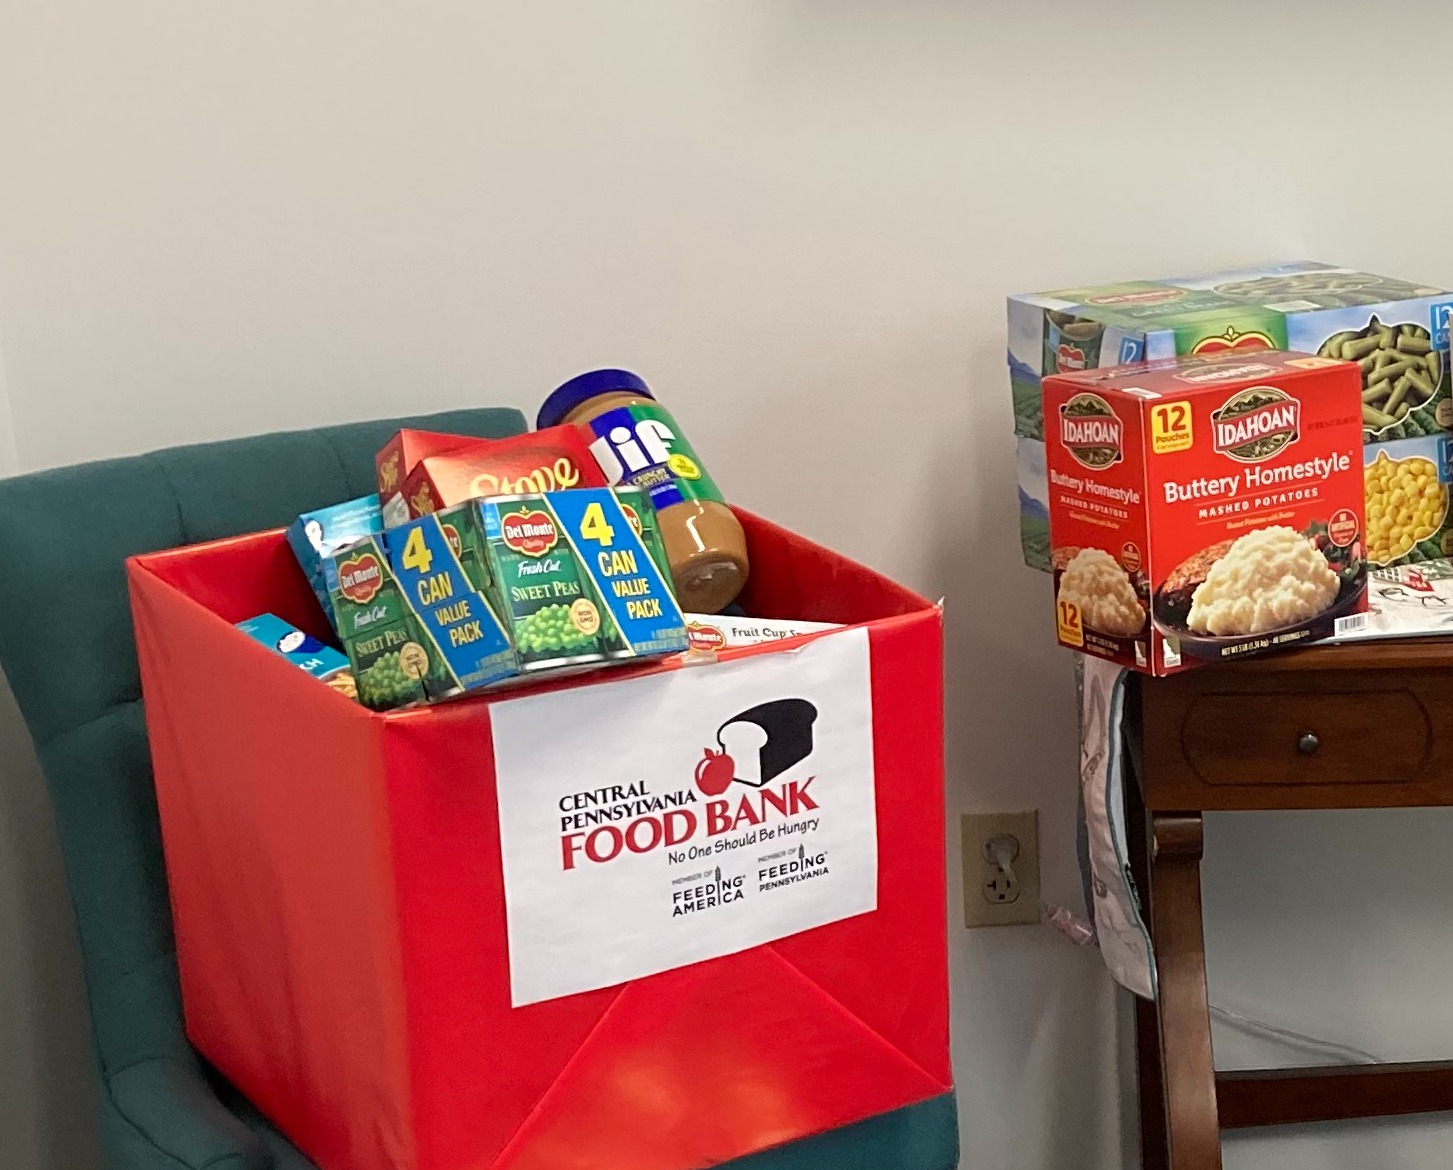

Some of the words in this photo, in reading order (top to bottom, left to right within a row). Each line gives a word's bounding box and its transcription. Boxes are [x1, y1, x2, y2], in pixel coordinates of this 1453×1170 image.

[1063, 419, 1120, 446] IDAHOAN
[1157, 405, 1188, 434] 12
[1217, 405, 1296, 447] IDAHOAN
[1156, 431, 1190, 445] Pouches
[589, 419, 676, 487] Jif
[1050, 469, 1084, 493] Buttery
[1085, 478, 1141, 506] Homestyle
[1164, 474, 1240, 504] Buttery
[1244, 452, 1351, 490] Homestyle
[1199, 499, 1250, 519] MASHED
[1255, 487, 1319, 508] POTATOES
[505, 525, 523, 540] Del
[523, 521, 554, 539] Monte
[580, 502, 615, 547] 4
[402, 526, 433, 574] 4
[598, 549, 638, 577] CAN
[355, 564, 380, 583] Monte
[518, 560, 543, 578] Fresh
[543, 558, 562, 574] Cut
[417, 571, 453, 605] CAN
[511, 584, 551, 602] SWEET
[552, 580, 581, 597] PEAS
[611, 577, 651, 598] VALUE
[435, 599, 472, 627] VALUE
[626, 598, 663, 620] PACK
[1060, 602, 1079, 629] 12
[355, 635, 385, 656] SWEET
[449, 620, 485, 649] PACK
[732, 627, 760, 637] Fruit
[763, 629, 786, 639] Cup
[558, 780, 650, 812] CENTRAL
[560, 809, 698, 871] FOOD
[706, 775, 819, 837] BANK
[561, 789, 698, 832] PENNSYLVANIA
[668, 851, 686, 866] No
[688, 845, 713, 863] One
[714, 832, 757, 854] Should
[759, 827, 776, 842] Be
[777, 816, 820, 839] Hungry
[757, 852, 786, 864] MEMBER
[671, 873, 702, 886] MEMBER
[703, 869, 714, 879] OF
[759, 867, 830, 893] PENNSYLVANIA
[671, 888, 745, 918] AMERICA
